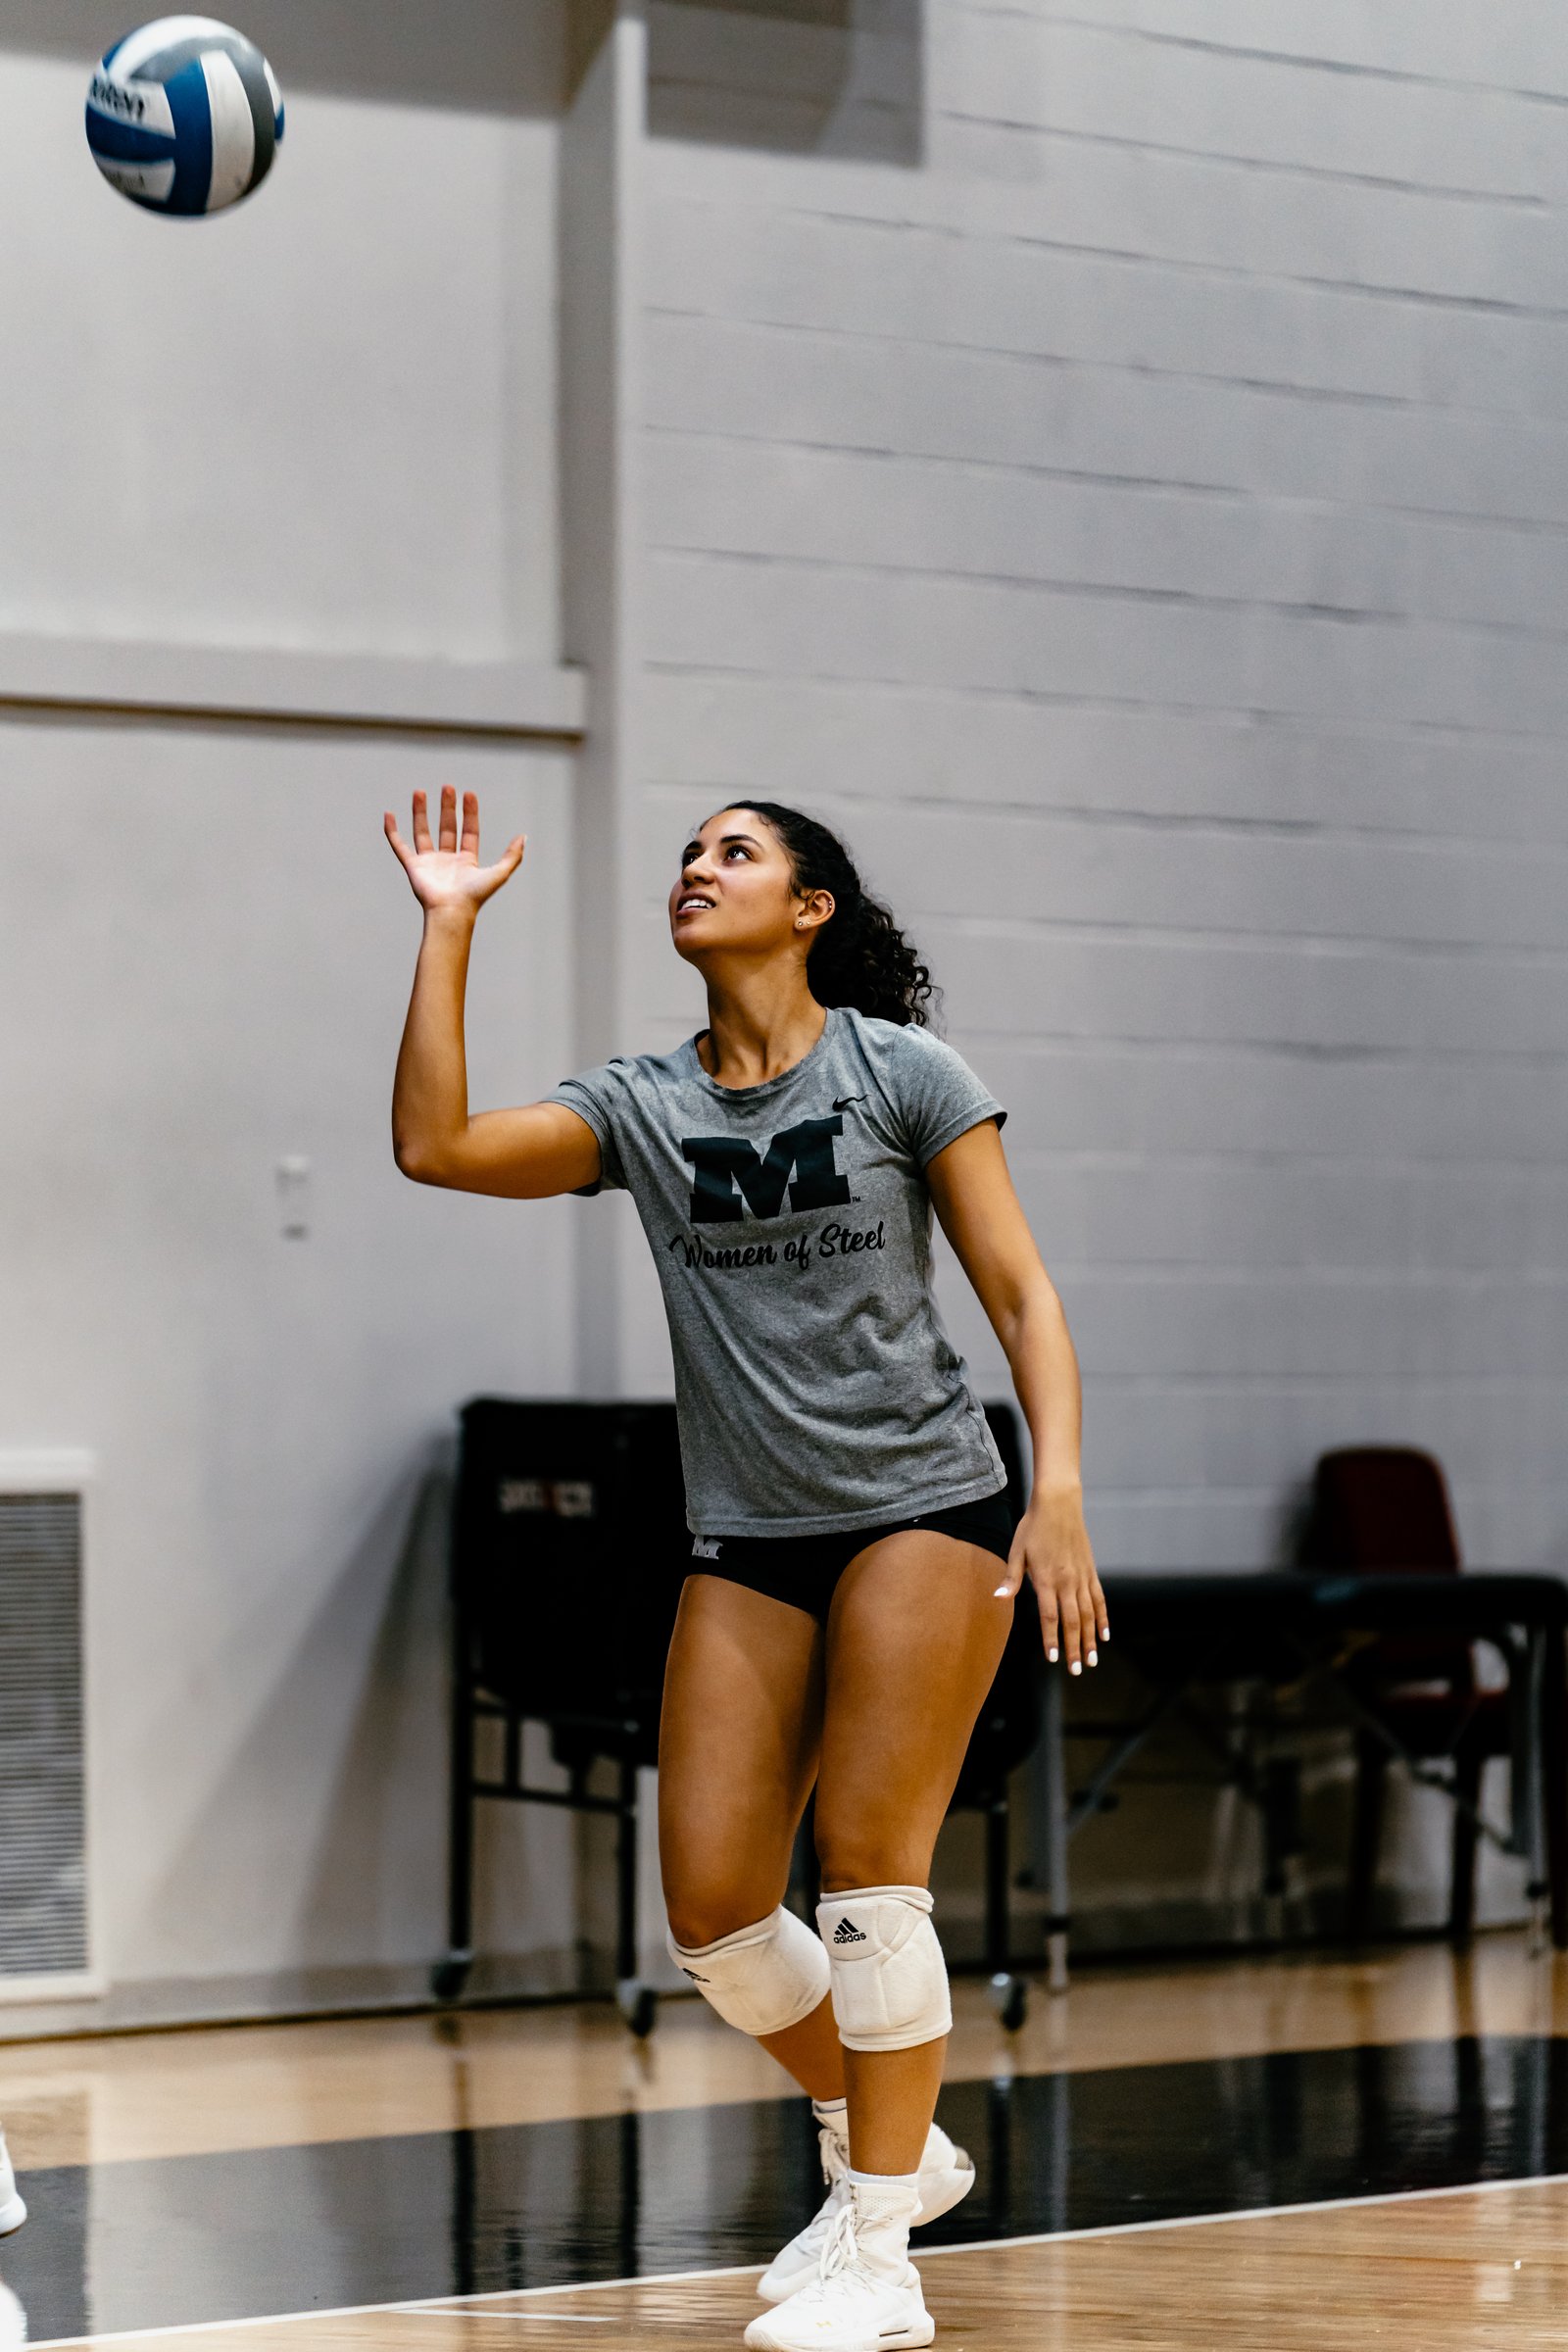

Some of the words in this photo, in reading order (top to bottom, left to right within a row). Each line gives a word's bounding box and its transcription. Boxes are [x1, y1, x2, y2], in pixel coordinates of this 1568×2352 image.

[681, 1114, 851, 1223] M
[669, 1234, 777, 1269] Women
[784, 1234, 810, 1270] of
[818, 1220, 885, 1258] Steel
[833, 1932, 867, 1943] adidas
